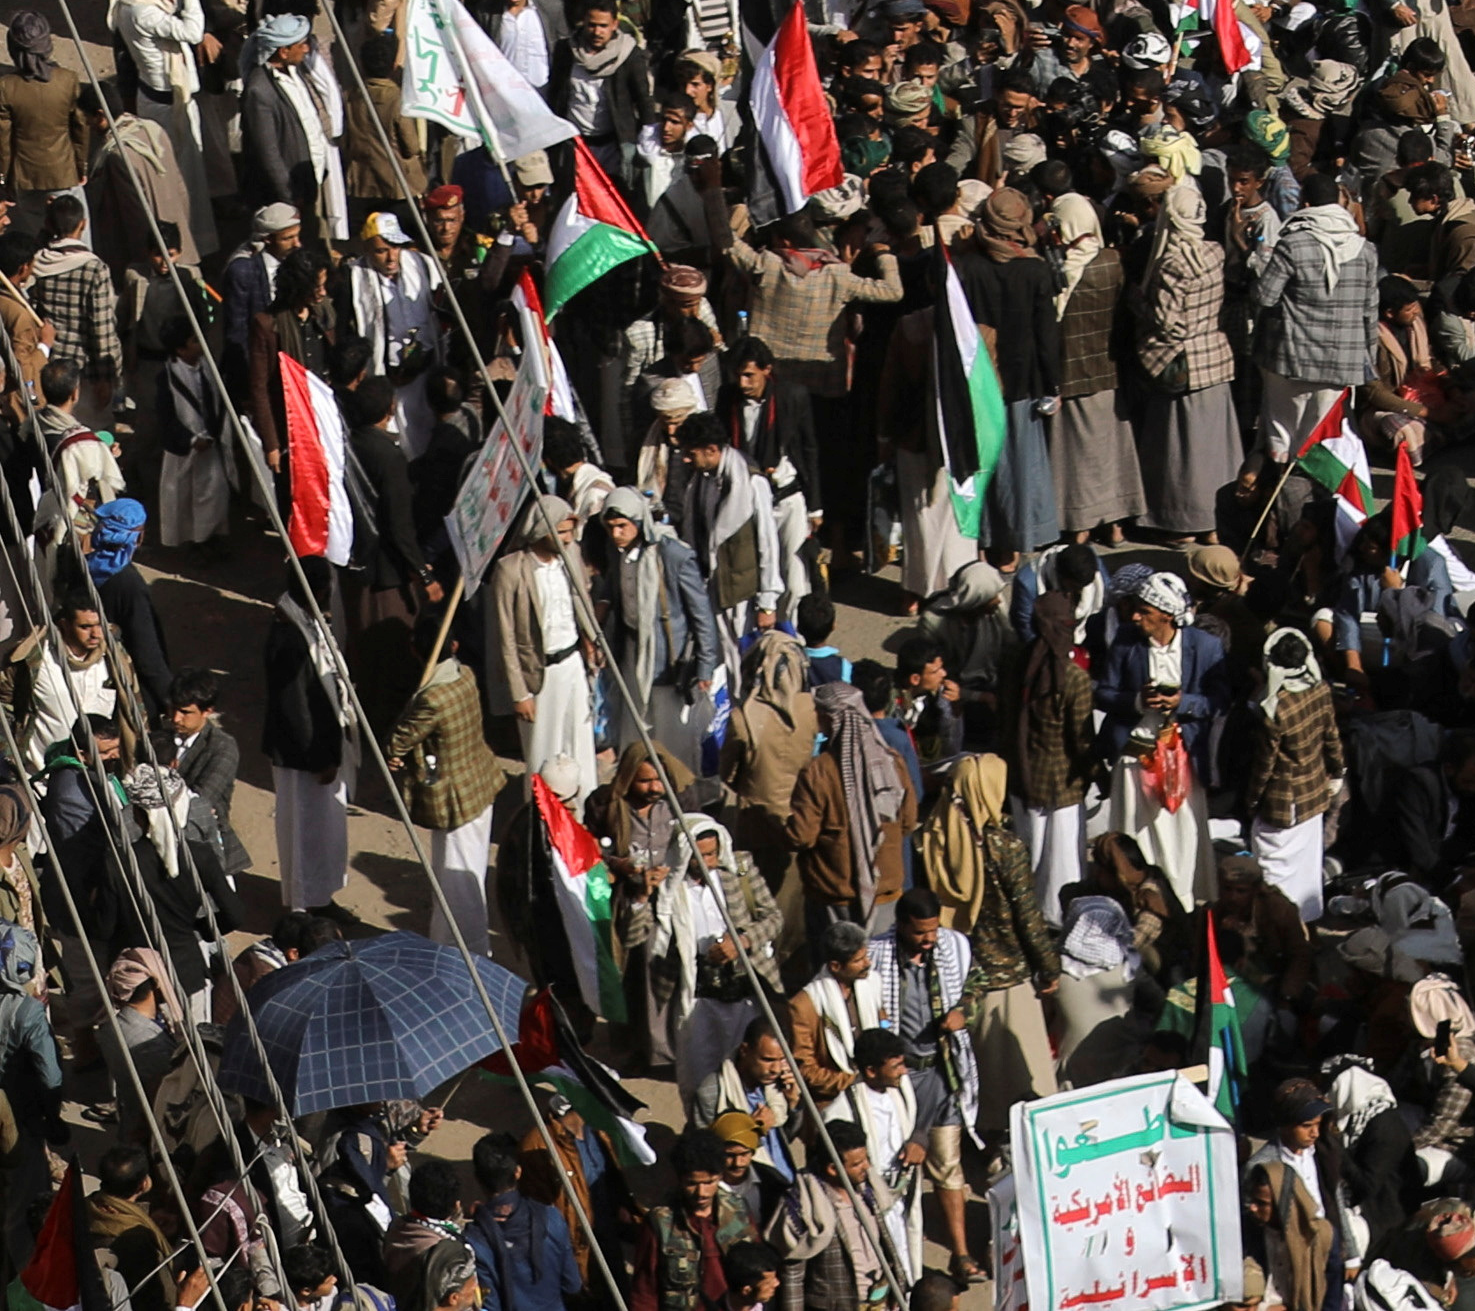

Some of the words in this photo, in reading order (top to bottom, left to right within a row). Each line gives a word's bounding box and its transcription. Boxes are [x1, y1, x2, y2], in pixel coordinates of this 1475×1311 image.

[1052, 1172, 1131, 1226] الأمريكية
[1135, 1162, 1201, 1213] البضائع
[1058, 1253, 1208, 1310] الإسرائيلية
